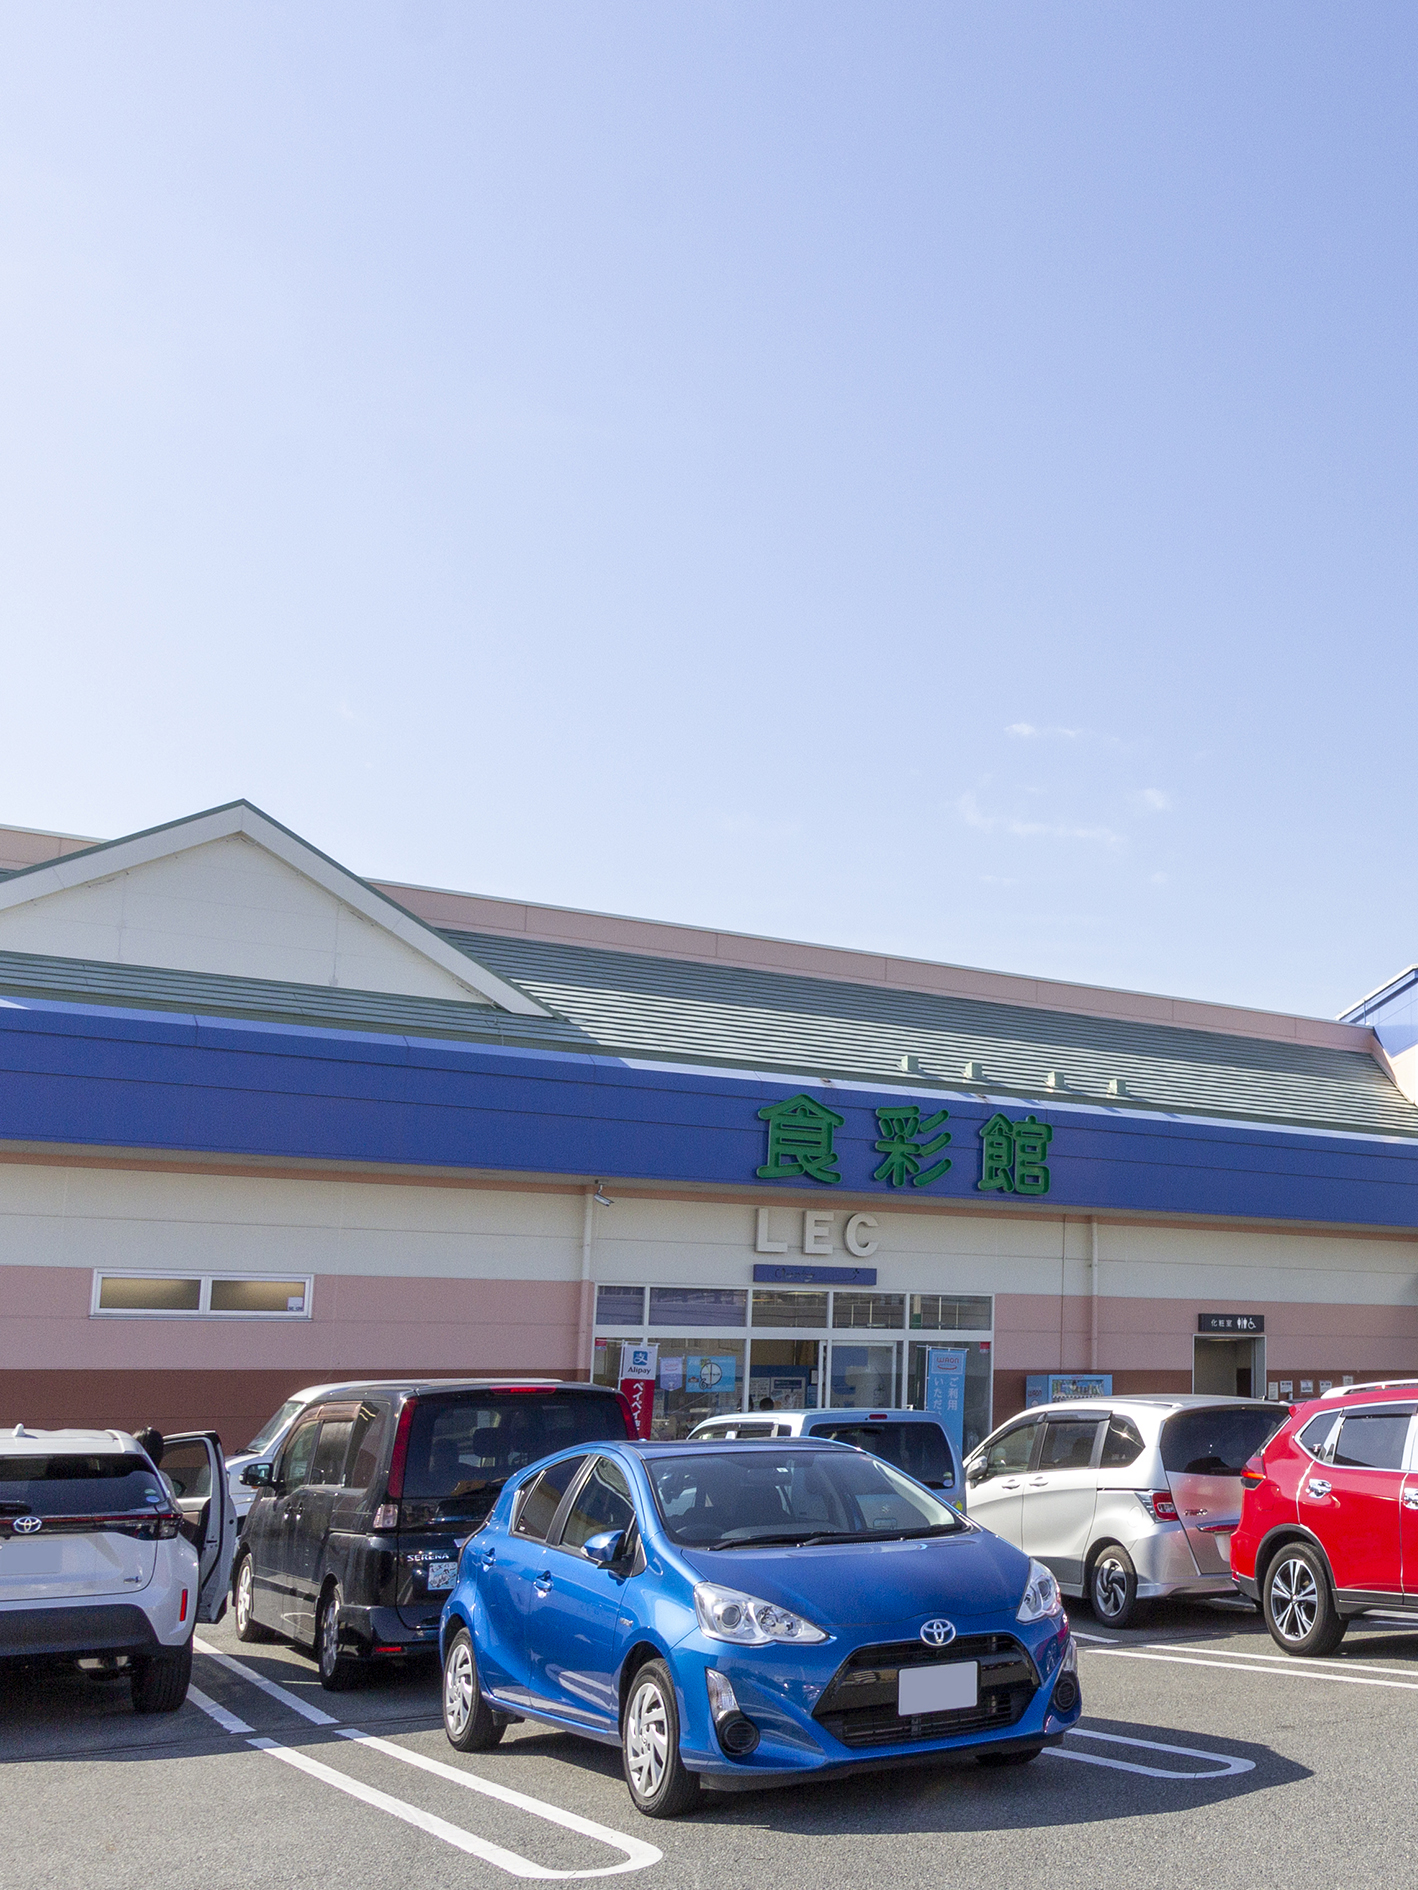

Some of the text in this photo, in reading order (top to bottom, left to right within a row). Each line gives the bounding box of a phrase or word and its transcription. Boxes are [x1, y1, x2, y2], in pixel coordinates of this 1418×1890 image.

[757, 1093, 1053, 1195] 食彩館
[755, 1208, 880, 1258] LEC
[627, 1366, 651, 1375] Alipay
[947, 1377, 960, 1410] ご利用
[406, 1554, 450, 1562] SERENA
